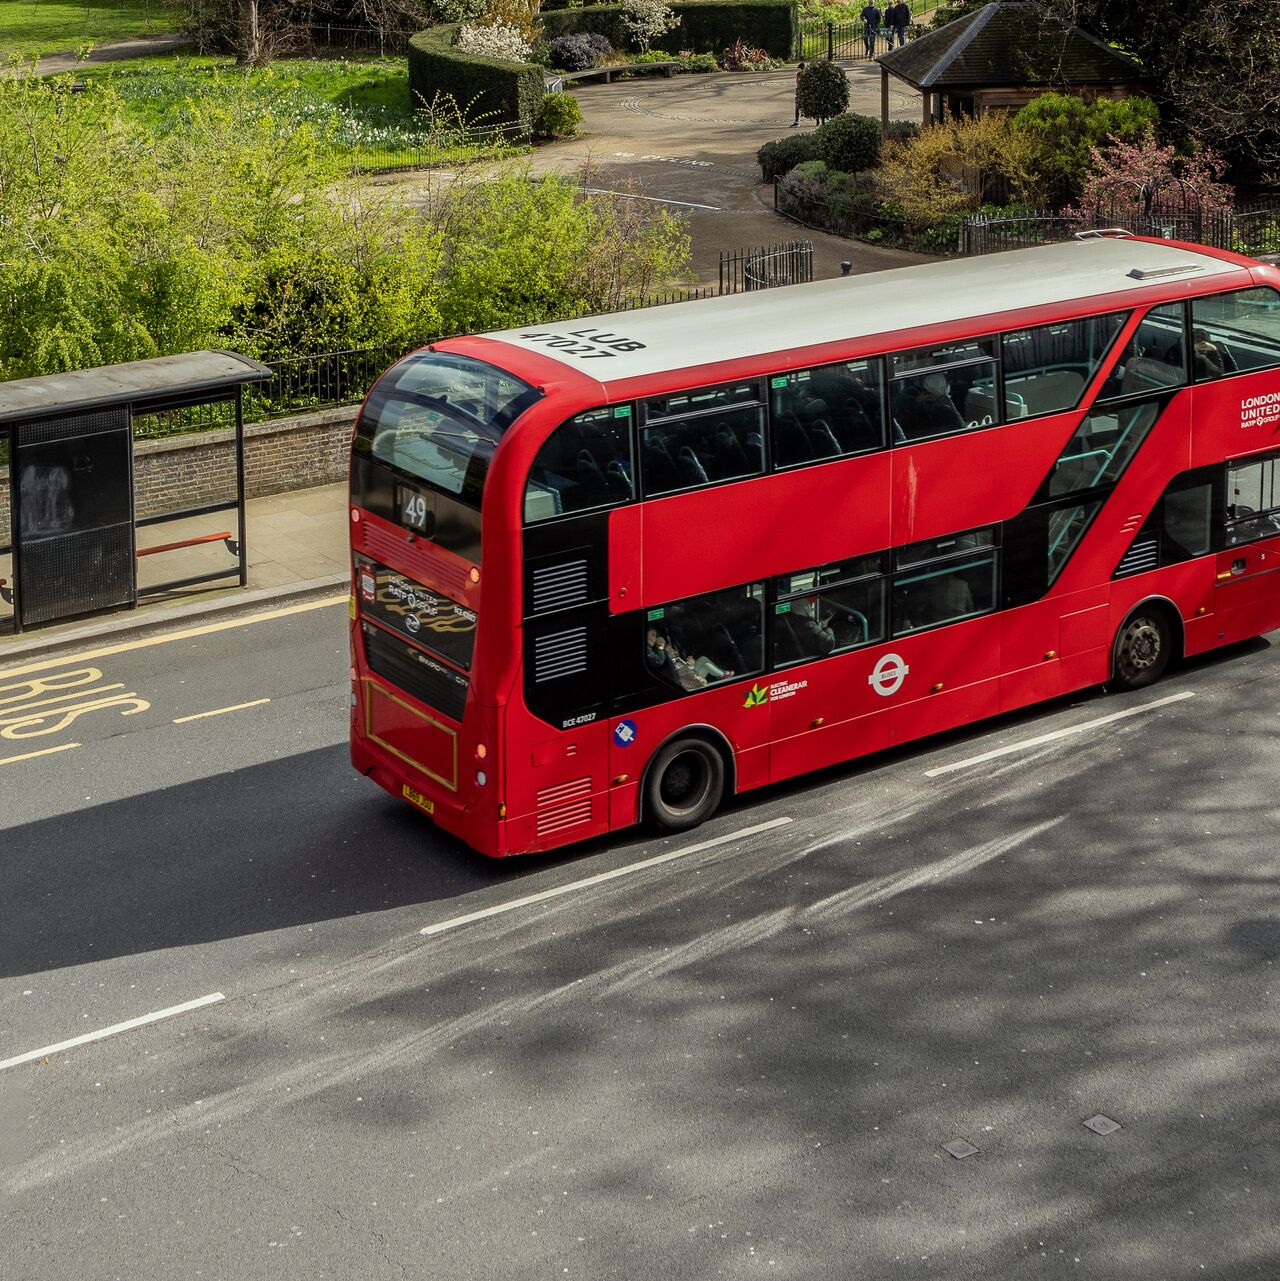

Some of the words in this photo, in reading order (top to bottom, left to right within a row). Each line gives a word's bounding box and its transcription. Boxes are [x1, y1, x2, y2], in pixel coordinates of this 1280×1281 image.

[520, 333, 617, 359] 47027
[567, 328, 647, 352] LUB
[1241, 392, 1280, 409] LONDON
[1241, 404, 1280, 420] UNITED
[1241, 420, 1256, 428] RATP
[1263, 414, 1280, 423] GROUP
[405, 495, 426, 527] 49
[389, 584, 407, 600] RATP
[881, 671, 897, 679] BUSES
[562, 718, 576, 728] BCE
[576, 712, 597, 724] 47027
